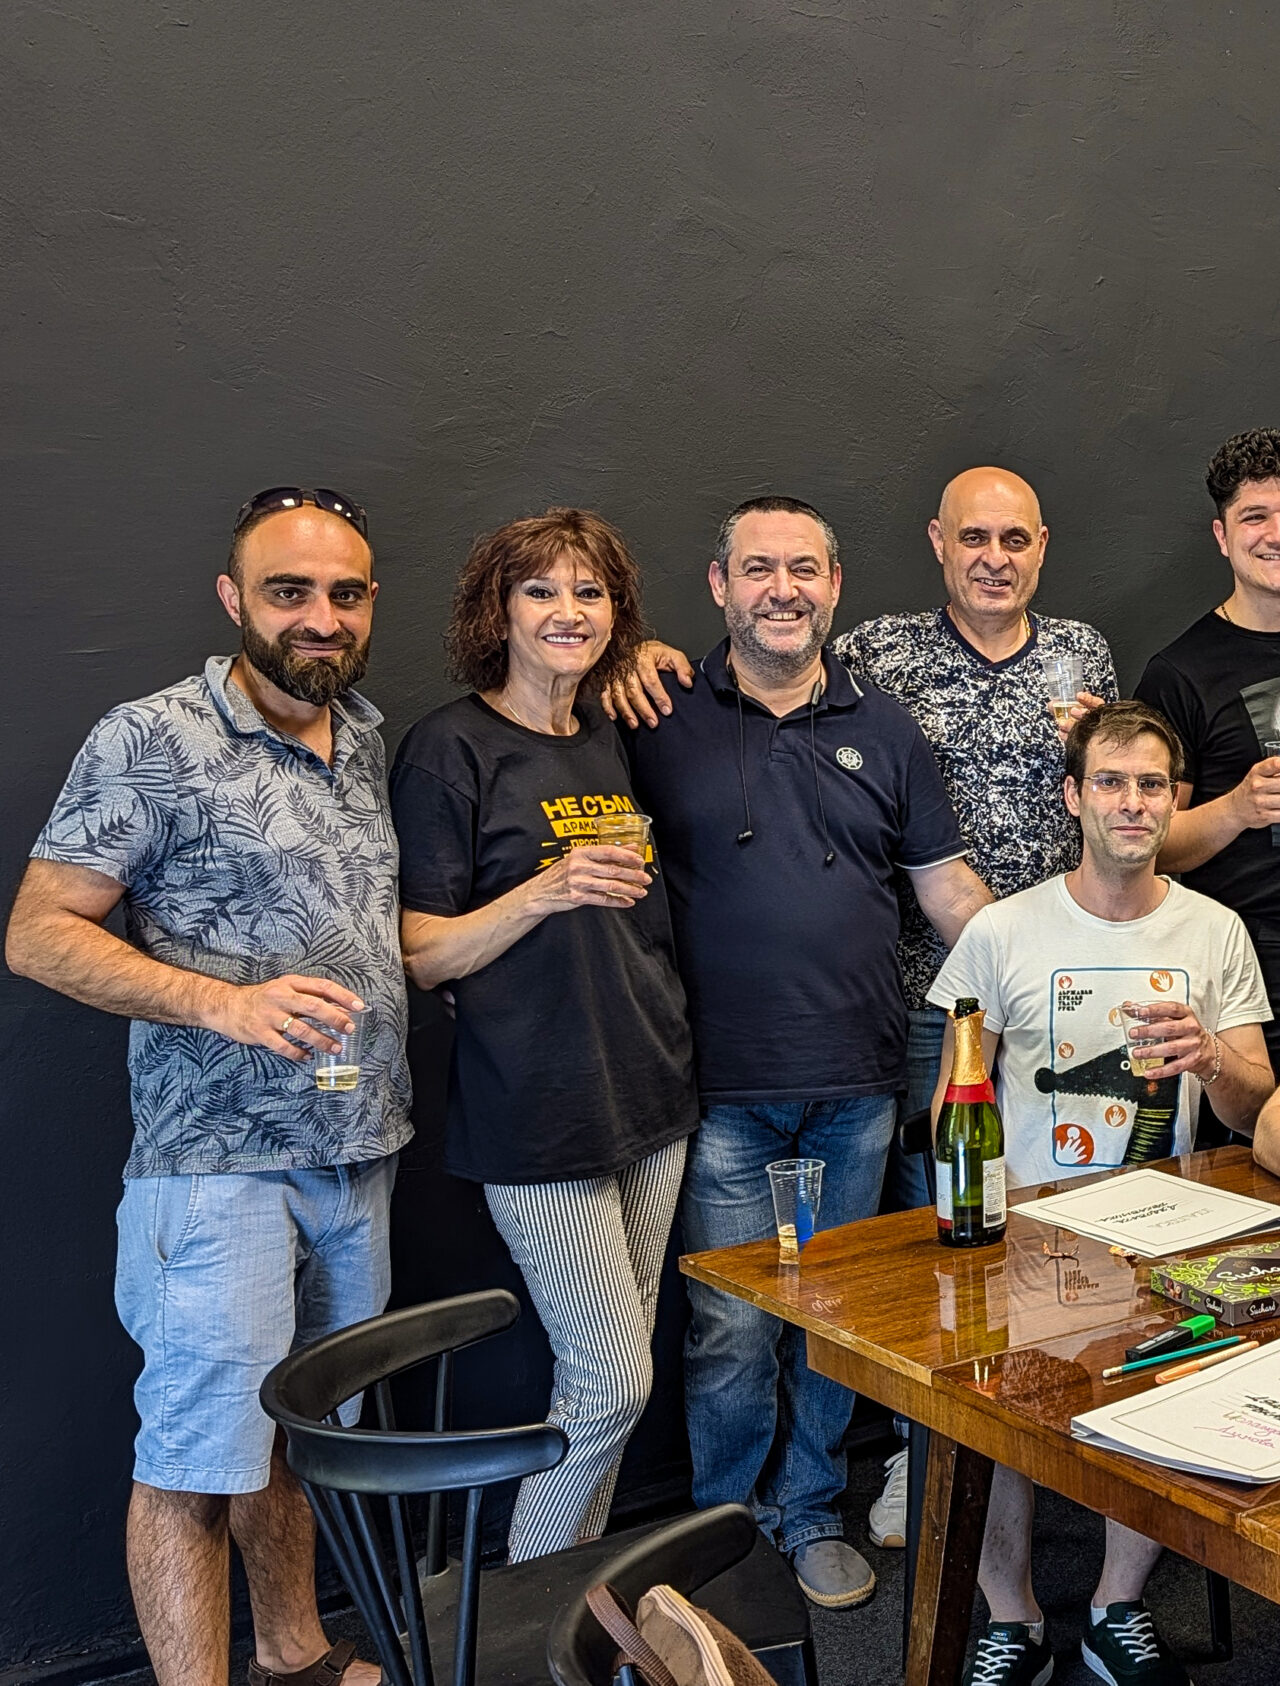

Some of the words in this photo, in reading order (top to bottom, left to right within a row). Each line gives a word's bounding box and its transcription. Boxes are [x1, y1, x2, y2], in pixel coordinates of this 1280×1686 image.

[541, 796, 582, 819] НЕ
[582, 795, 636, 816] СЪМ
[563, 820, 598, 833] ДРАМА
[1249, 1300, 1276, 1316] Suchard
